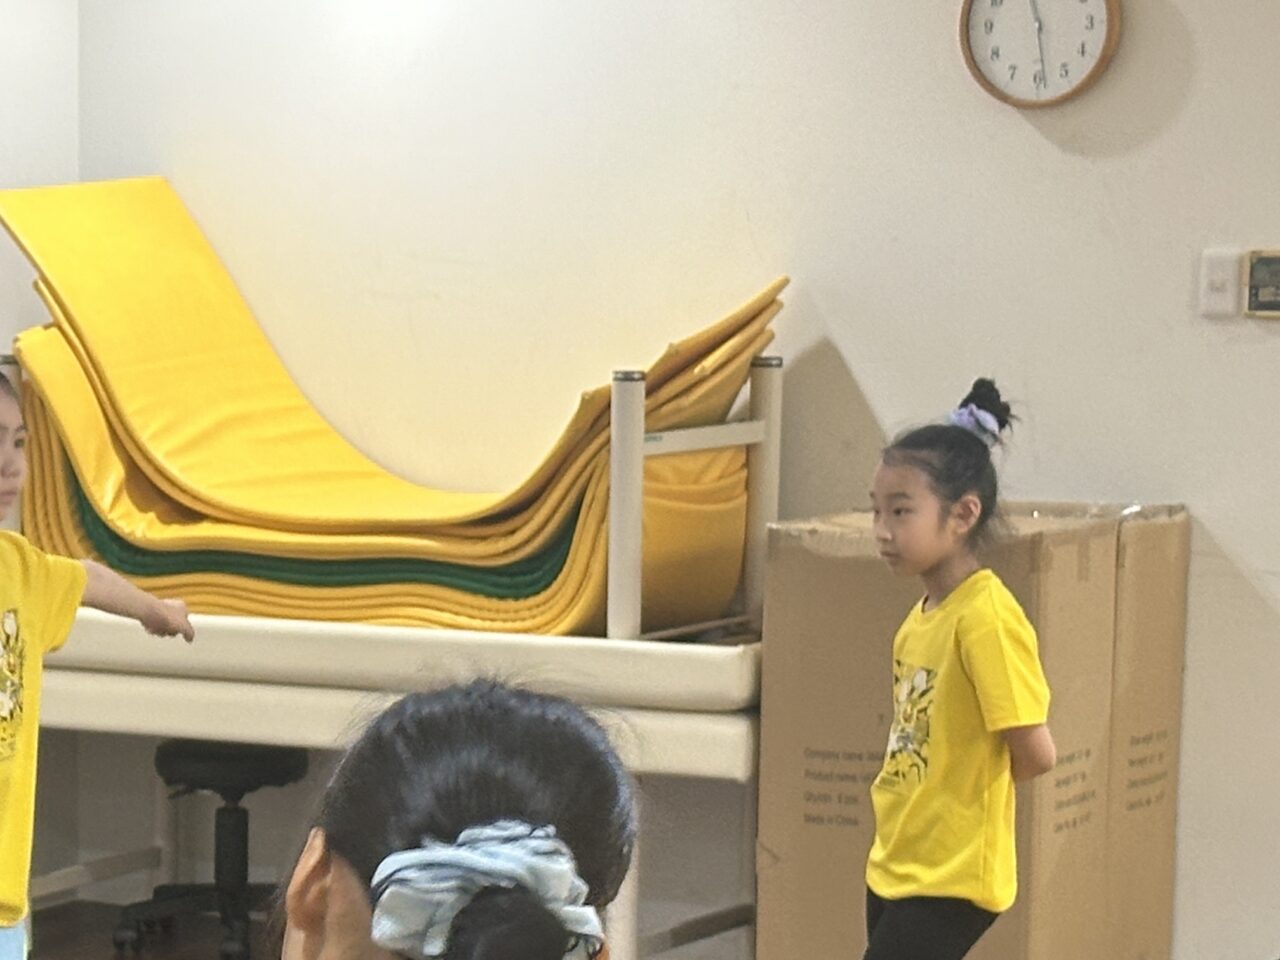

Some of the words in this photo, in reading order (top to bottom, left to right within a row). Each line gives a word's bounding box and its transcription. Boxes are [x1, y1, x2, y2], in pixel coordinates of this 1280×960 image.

[984, 18, 994, 34] 9
[1085, 14, 1095, 30] 3
[990, 46, 1000, 61] 8
[1077, 42, 1086, 57] 4
[1008, 64, 1018, 80] 7
[1059, 62, 1069, 78] 5
